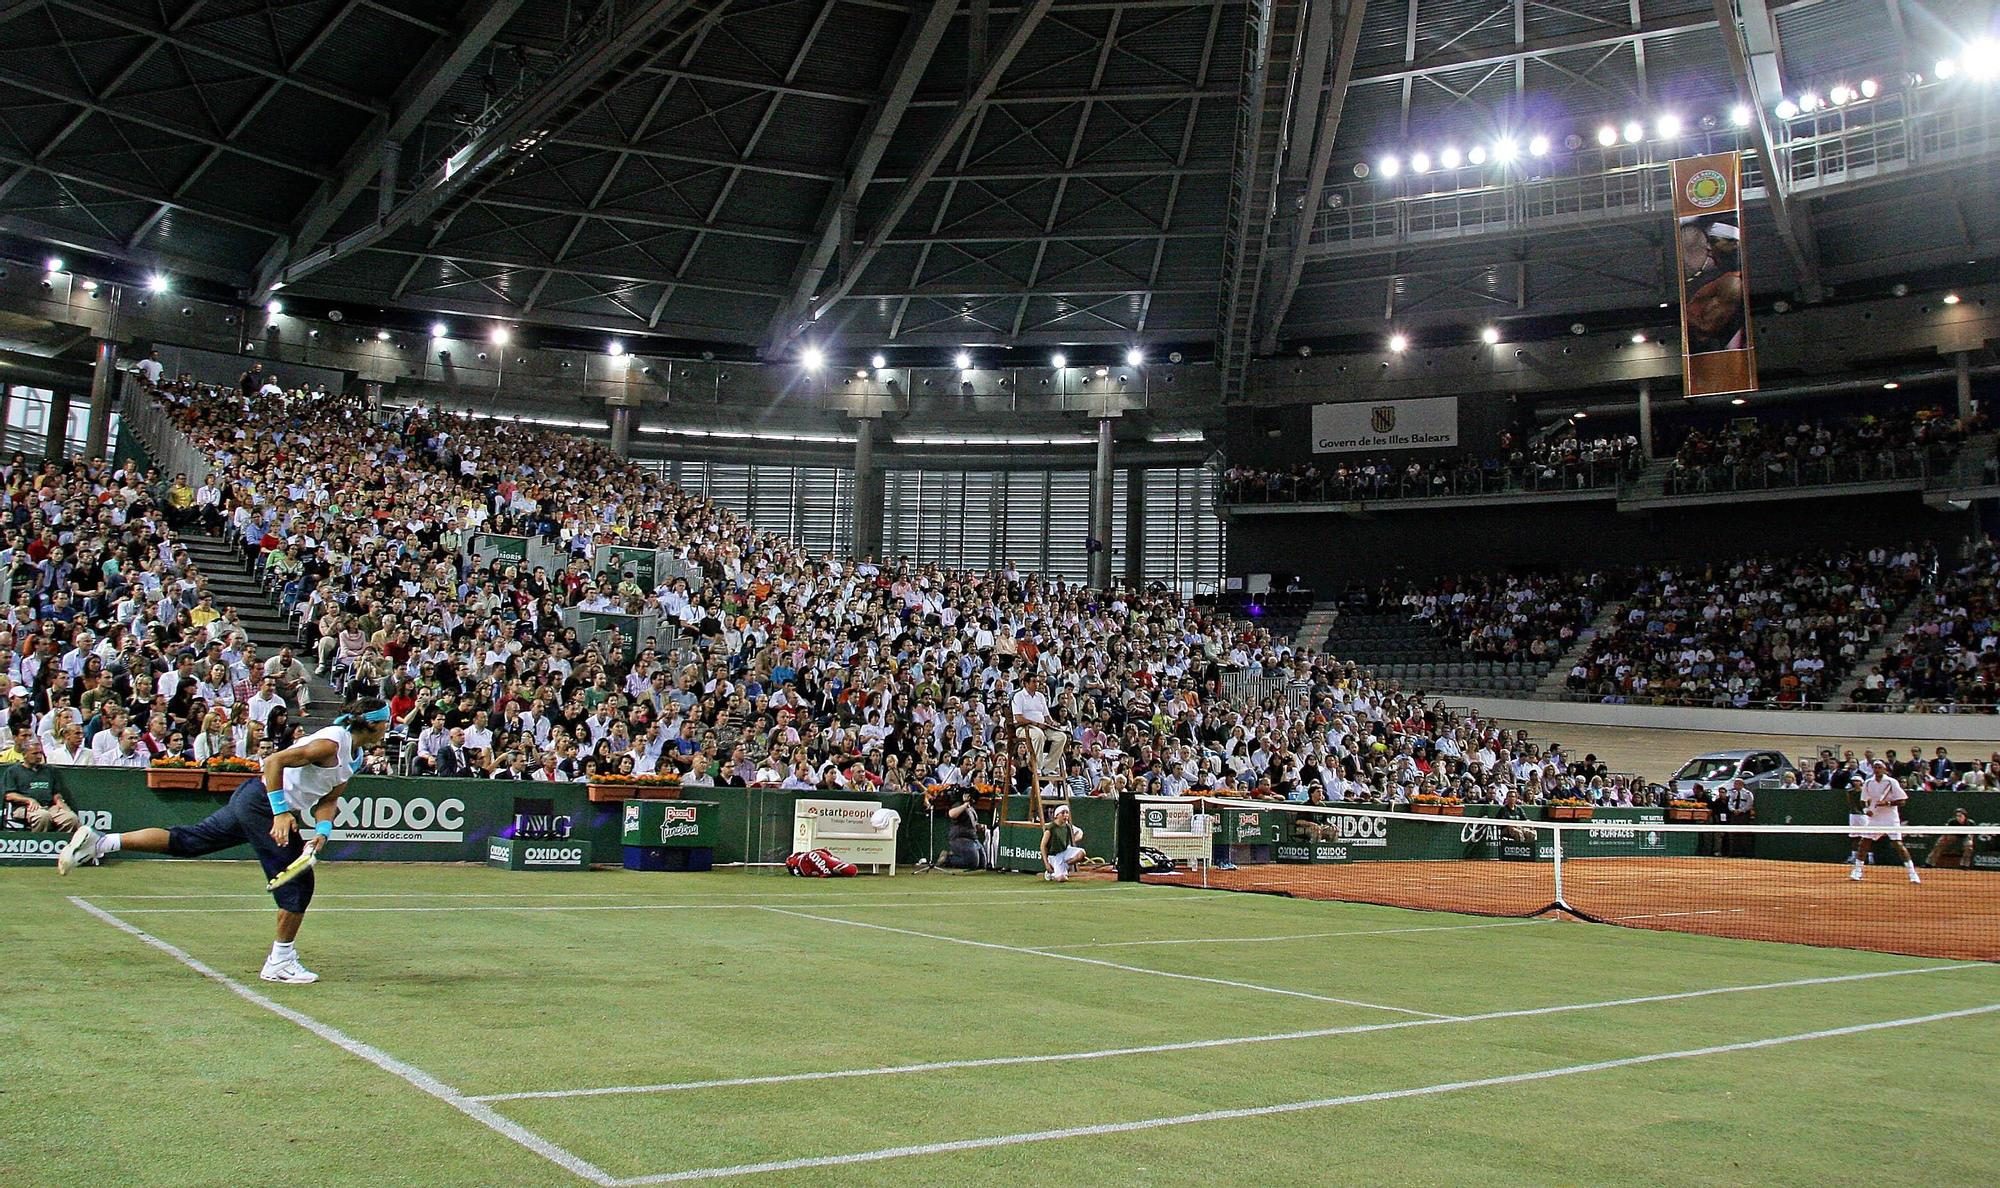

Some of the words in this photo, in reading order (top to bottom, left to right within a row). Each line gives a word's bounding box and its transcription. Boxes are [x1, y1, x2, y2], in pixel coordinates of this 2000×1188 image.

[1319, 439, 1356, 448] Govern
[1358, 436, 1371, 446] de
[1373, 436, 1387, 445] les
[1389, 435, 1409, 445] Illes
[1411, 433, 1450, 443] Balears
[819, 807, 875, 819] startpeople
[1327, 816, 1387, 838] IDOC
[345, 831, 423, 840] www.oxidoc.com
[490, 844, 510, 858] OXIDOC
[525, 848, 582, 860] OXIDOC
[1015, 847, 1042, 860] Balears
[1278, 847, 1309, 856] OXIDOC
[1316, 847, 1347, 856] OXIDOC
